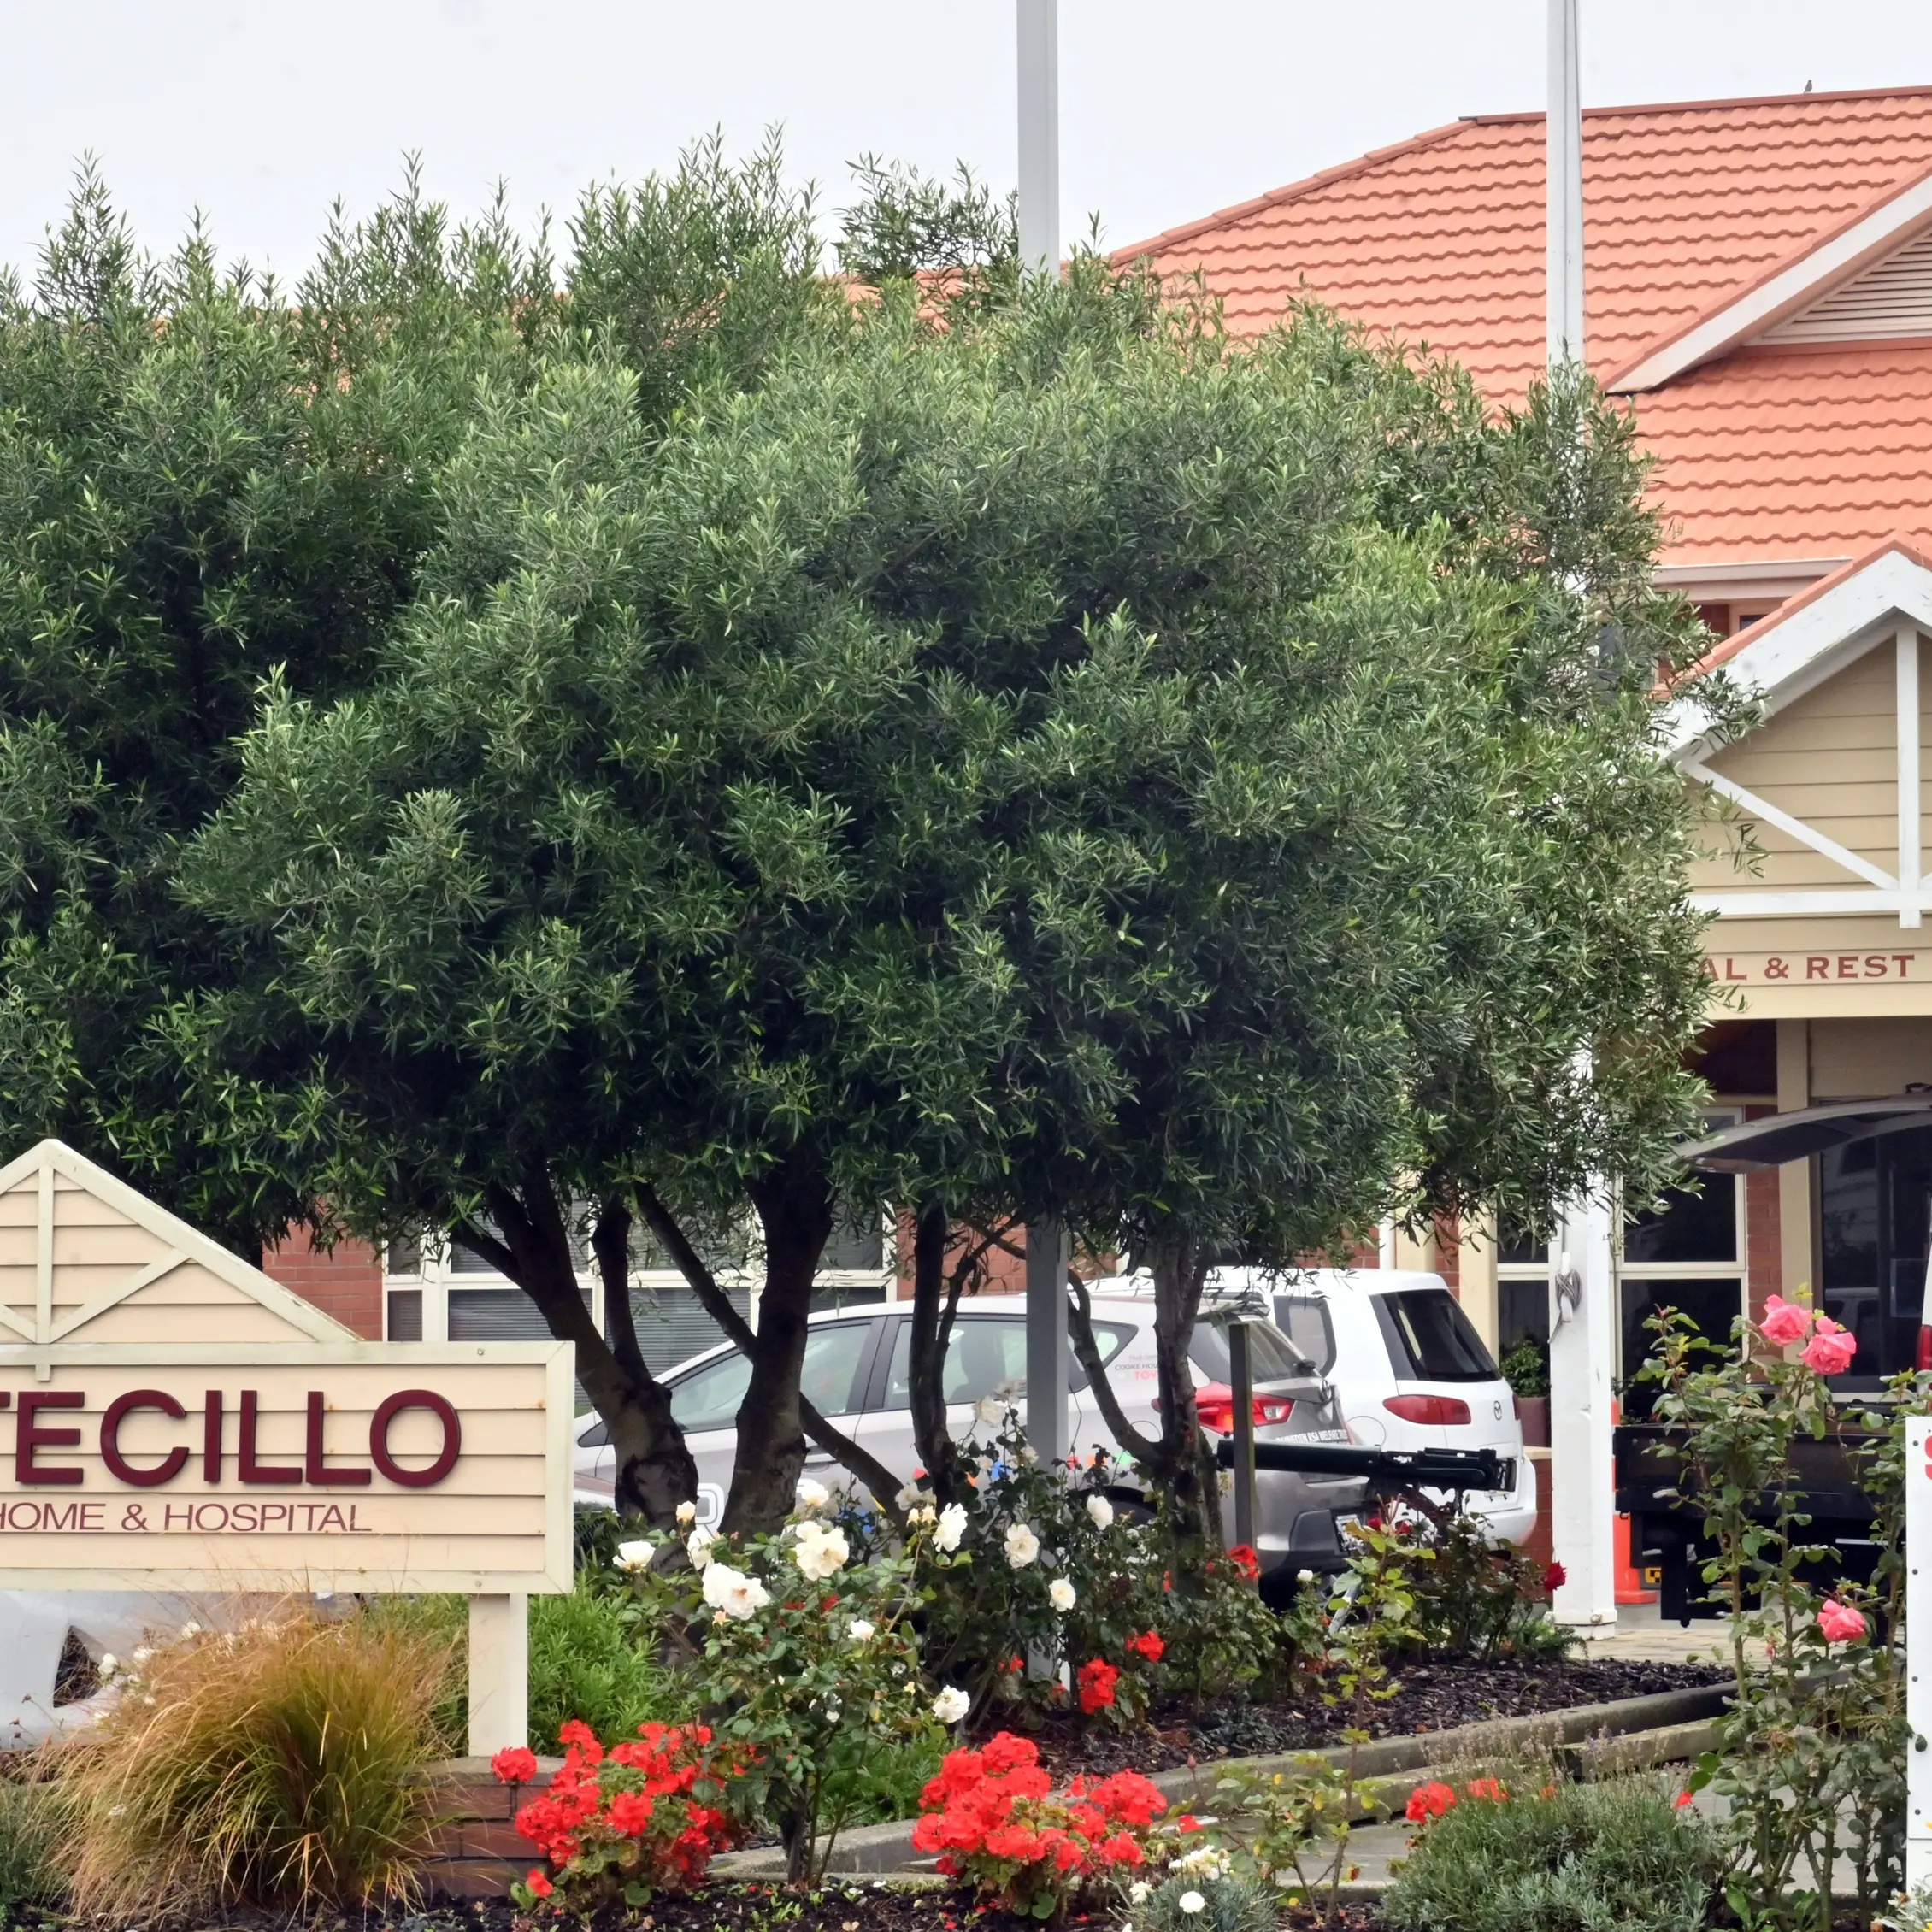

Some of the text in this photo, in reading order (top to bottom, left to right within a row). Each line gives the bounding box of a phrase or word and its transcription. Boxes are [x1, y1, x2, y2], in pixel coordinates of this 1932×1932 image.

[1764, 957, 1788, 980] &
[1805, 954, 1915, 980] REST
[0, 1388, 462, 1487] ECILLO
[0, 1502, 373, 1532] OME & HOSPITAL
